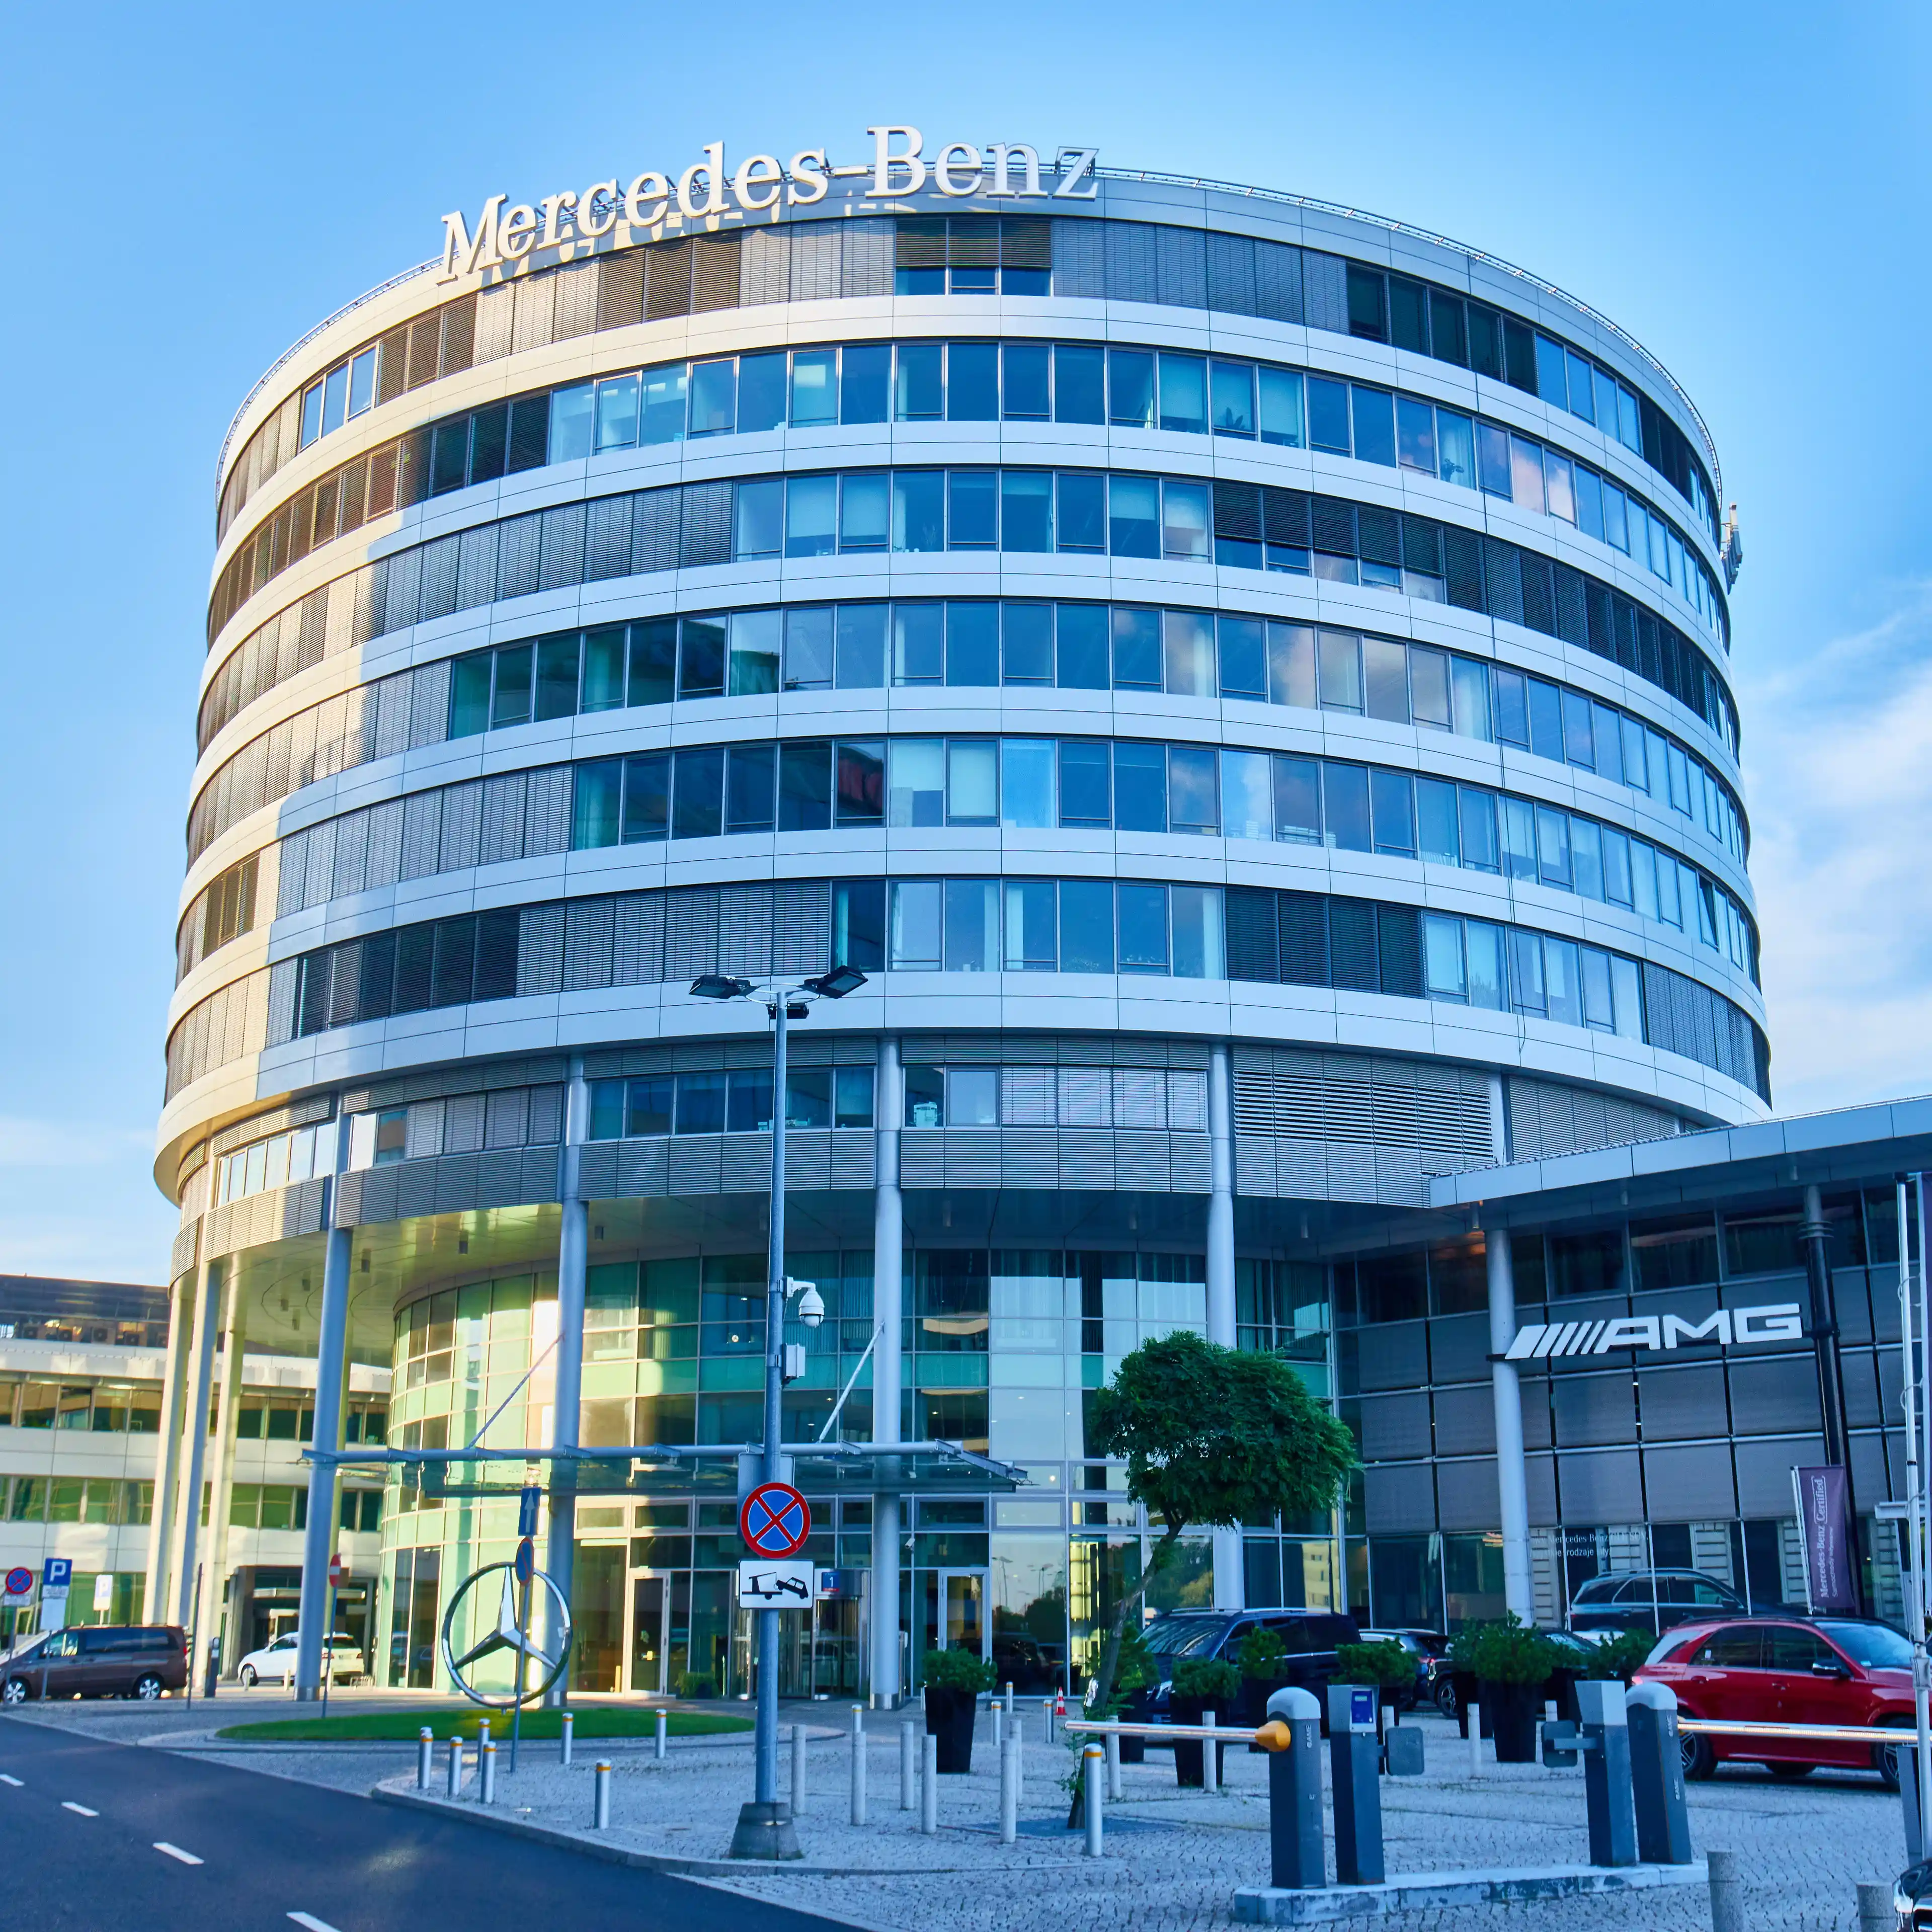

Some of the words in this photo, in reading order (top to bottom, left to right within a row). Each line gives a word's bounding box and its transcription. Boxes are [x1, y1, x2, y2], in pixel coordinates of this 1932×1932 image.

[436, 125, 1099, 284] Mercedes-Benz
[1593, 1303, 1803, 1354] AMG
[1814, 1478, 1826, 1521] Certified
[49, 1561, 66, 1582] P
[830, 1576, 833, 1588] 1
[1816, 1524, 1829, 1598] Mercedes-Benz
